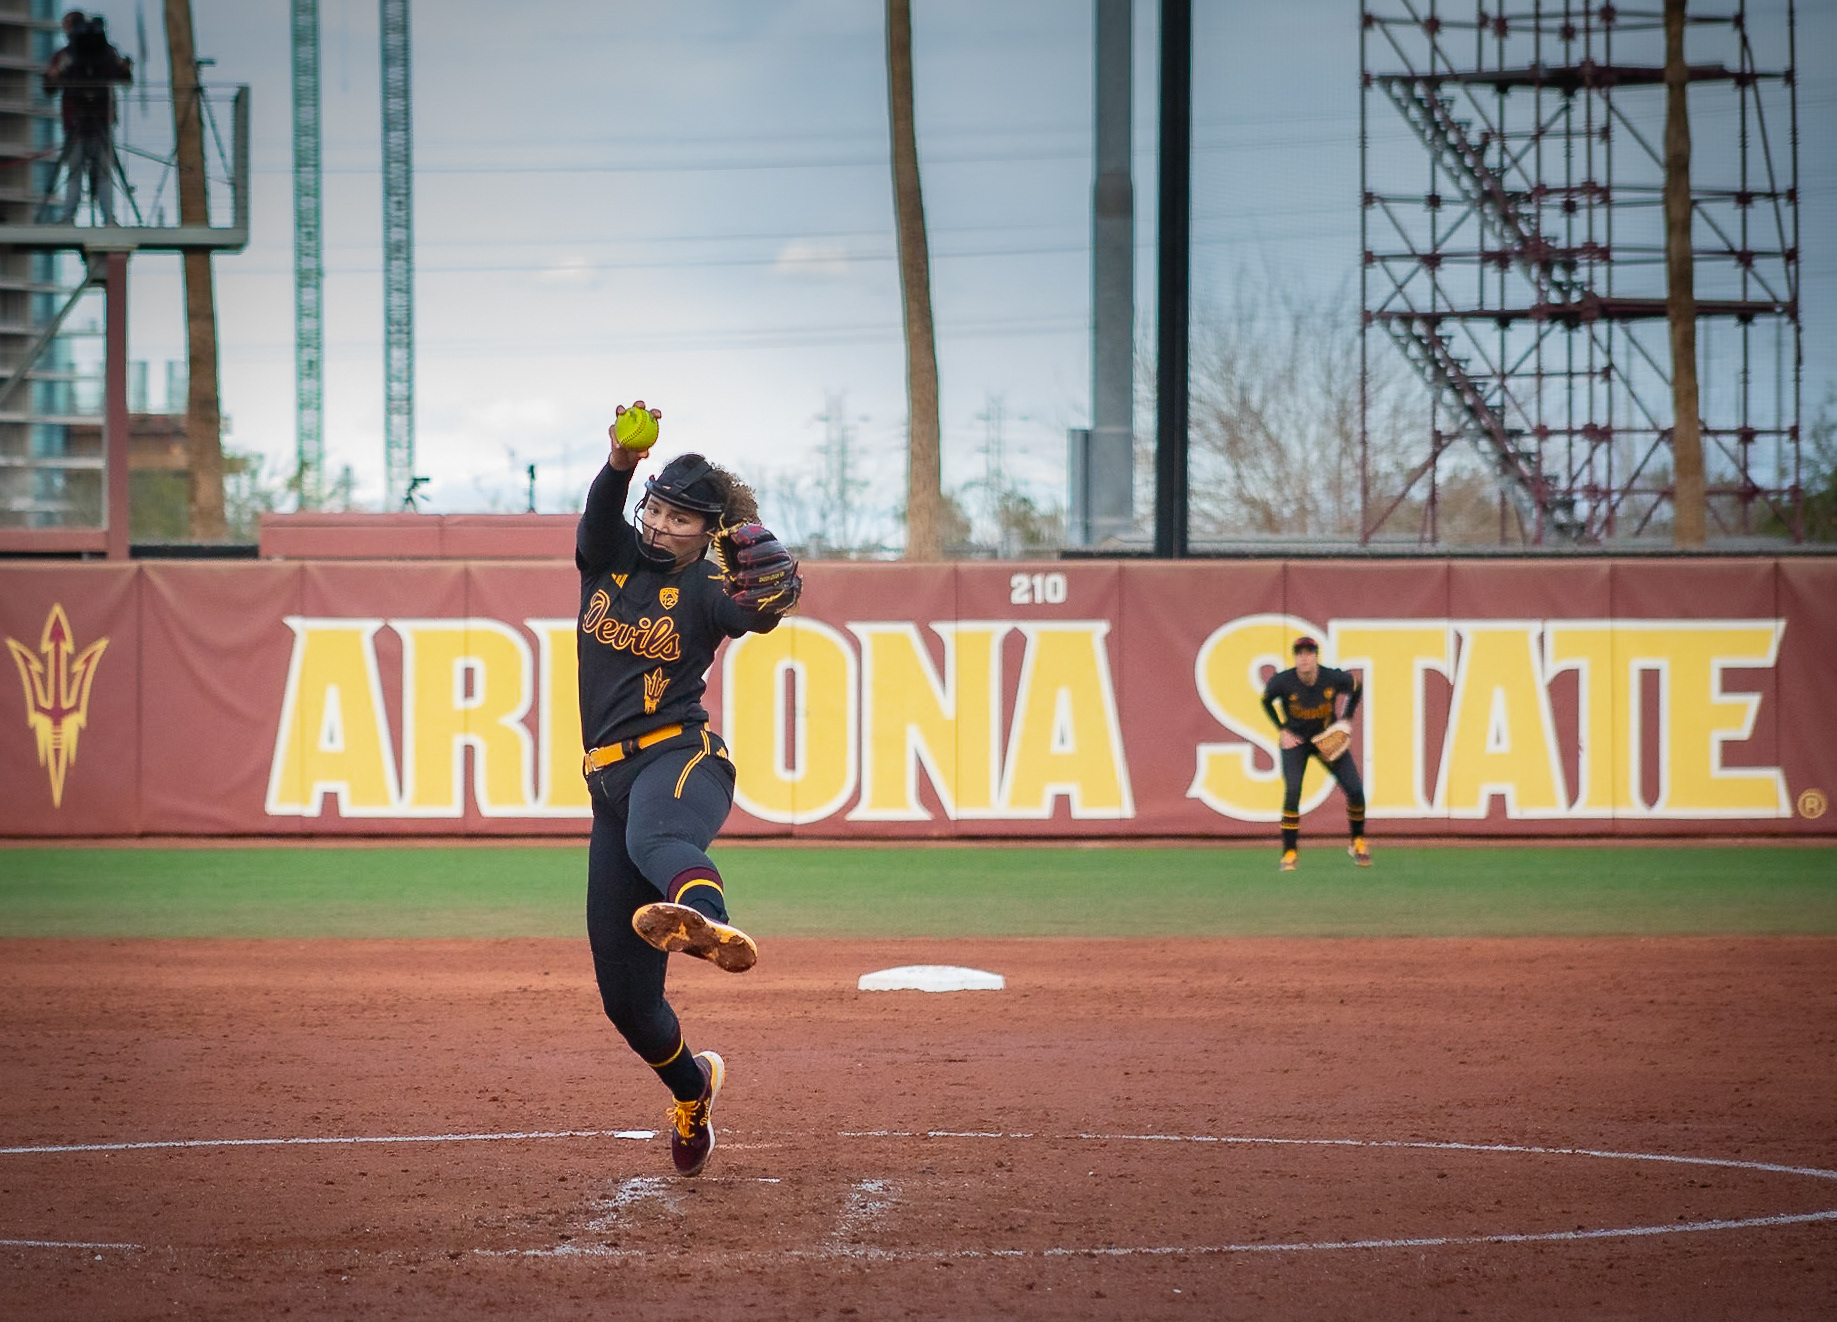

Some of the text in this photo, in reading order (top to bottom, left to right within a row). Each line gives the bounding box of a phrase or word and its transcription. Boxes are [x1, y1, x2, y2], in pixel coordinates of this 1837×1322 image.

[1010, 572, 1067, 605] 210
[582, 589, 681, 661] Devils
[265, 615, 1135, 824] ARIONA
[1185, 613, 1792, 823] STATE
